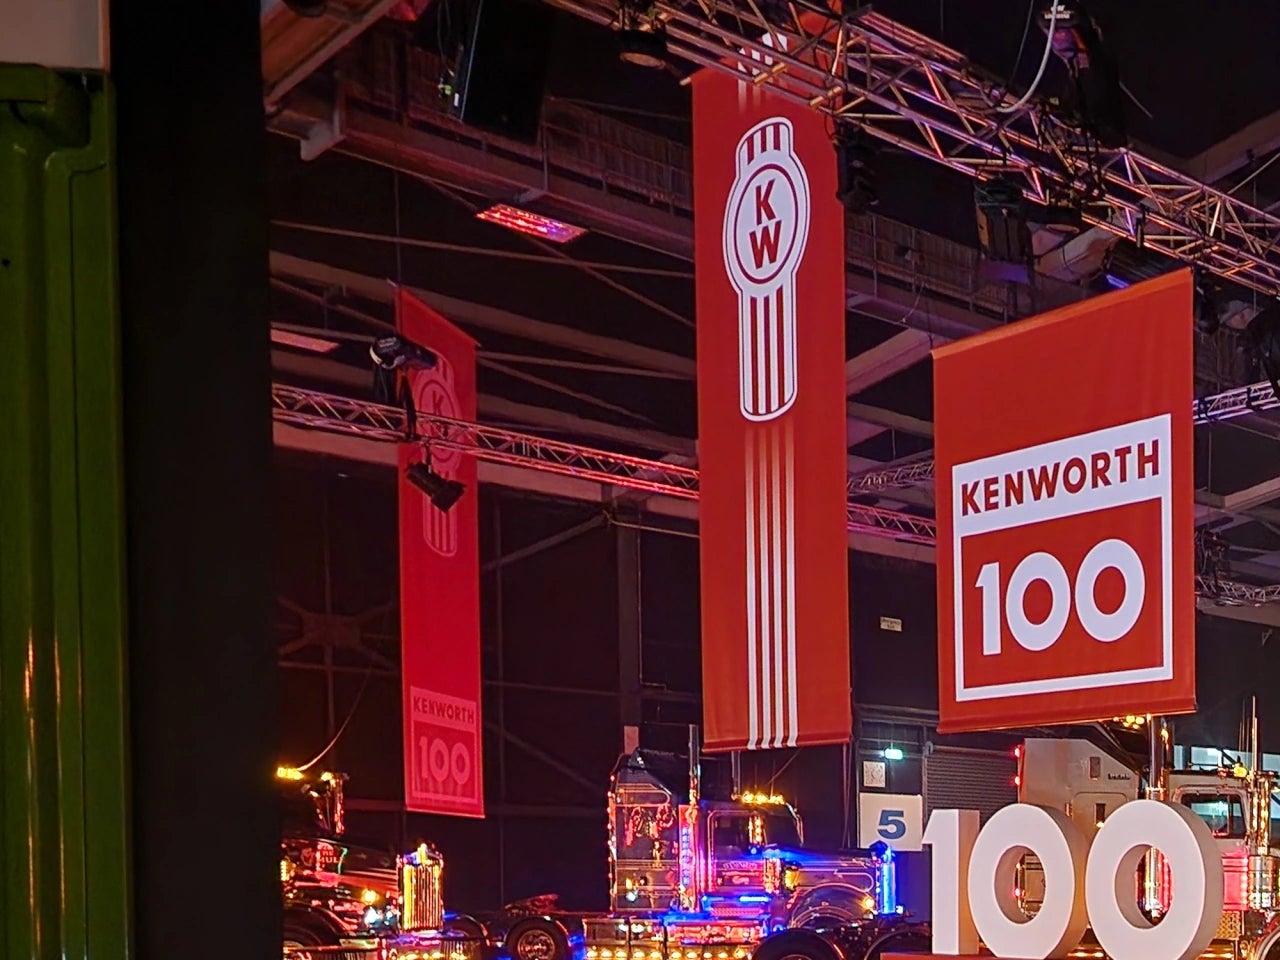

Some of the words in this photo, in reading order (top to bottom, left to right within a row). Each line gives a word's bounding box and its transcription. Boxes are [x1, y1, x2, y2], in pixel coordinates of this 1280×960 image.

[961, 439, 1159, 516] KENWORTH
[974, 538, 1146, 656] 100
[413, 696, 474, 724] KENWORTH
[419, 736, 470, 785] 100
[877, 809, 906, 840] 5
